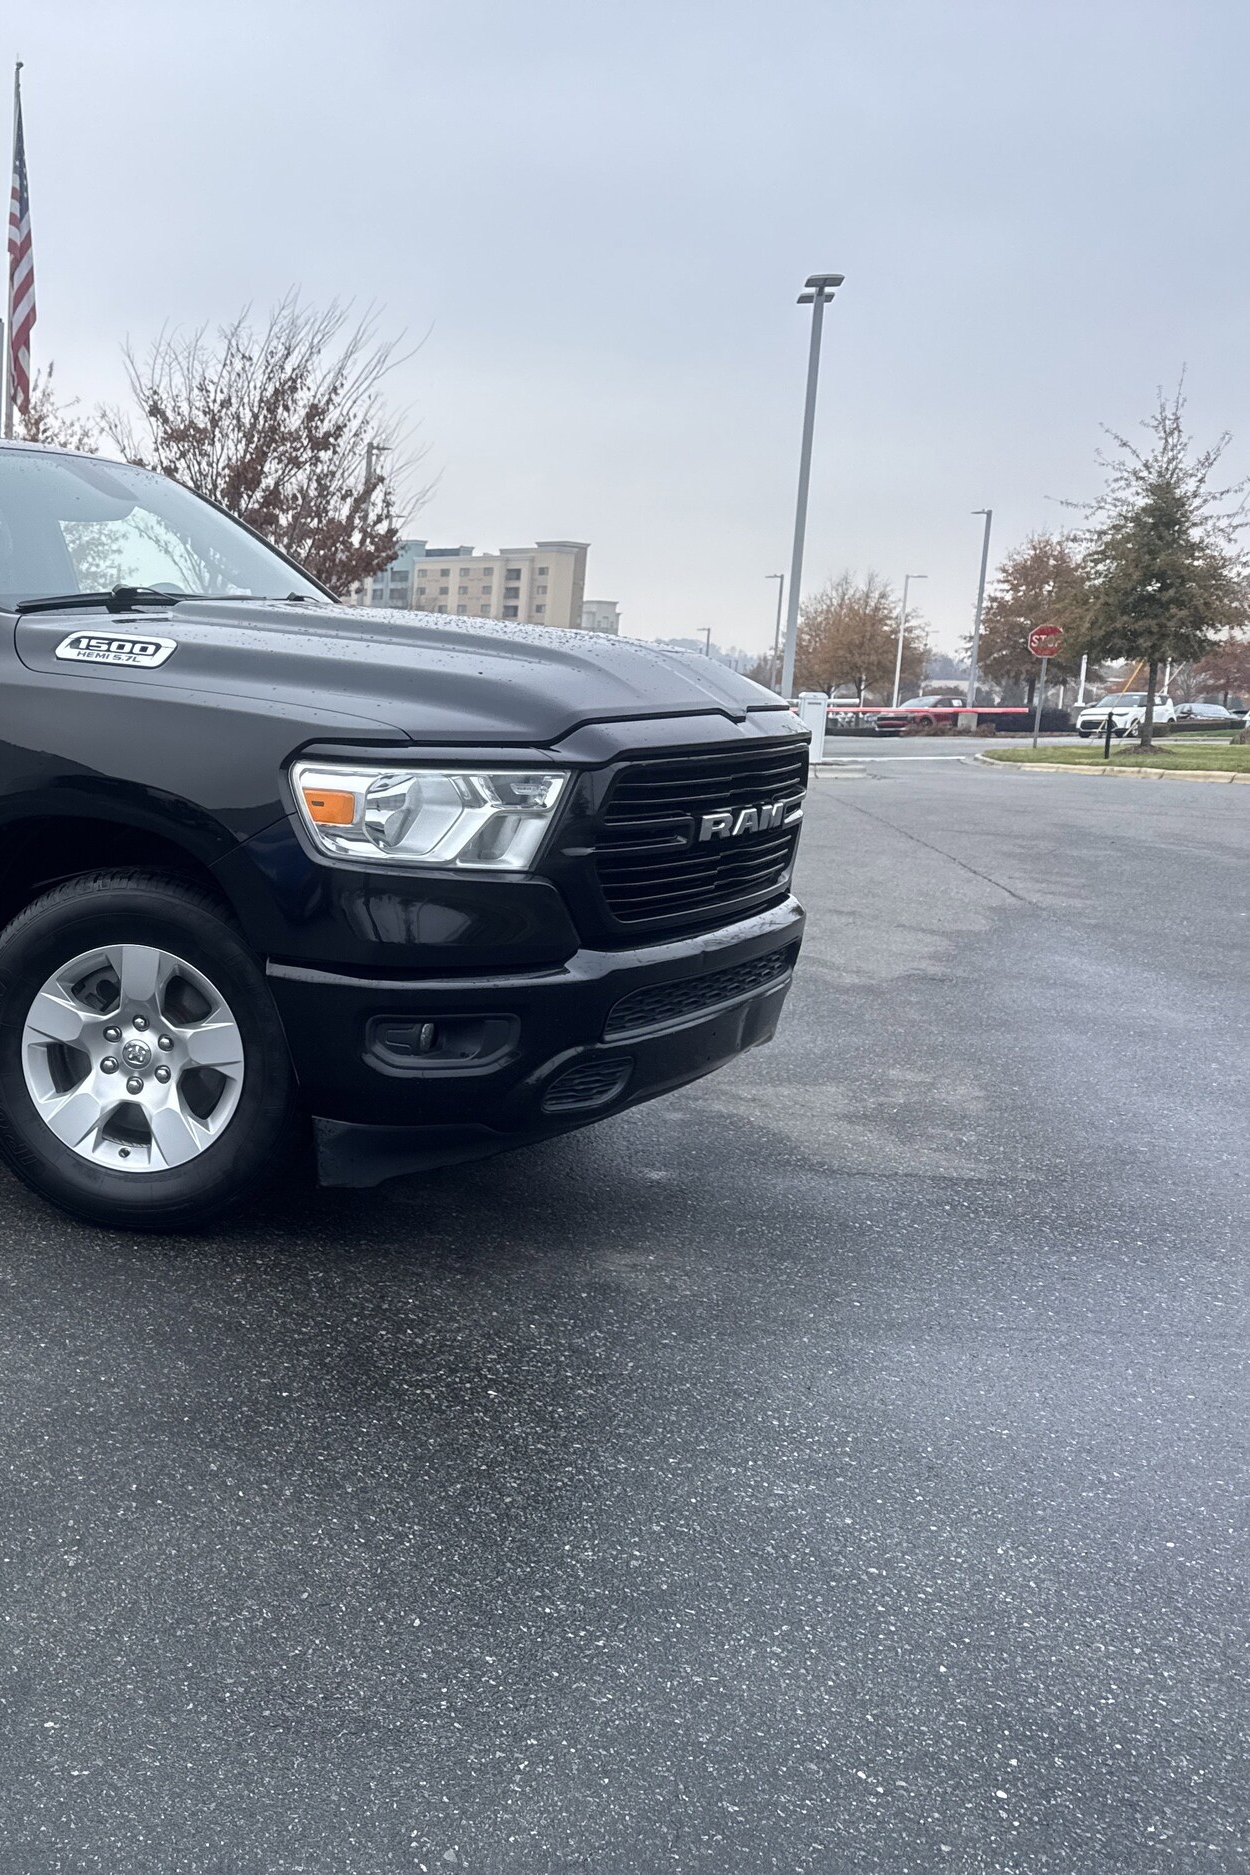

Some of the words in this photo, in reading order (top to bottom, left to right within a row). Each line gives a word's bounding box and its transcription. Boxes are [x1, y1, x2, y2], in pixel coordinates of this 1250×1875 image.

[78, 638, 156, 656] 1500
[76, 650, 110, 660] HEMI
[112, 655, 141, 663] 5.7L
[699, 802, 783, 842] RAM
